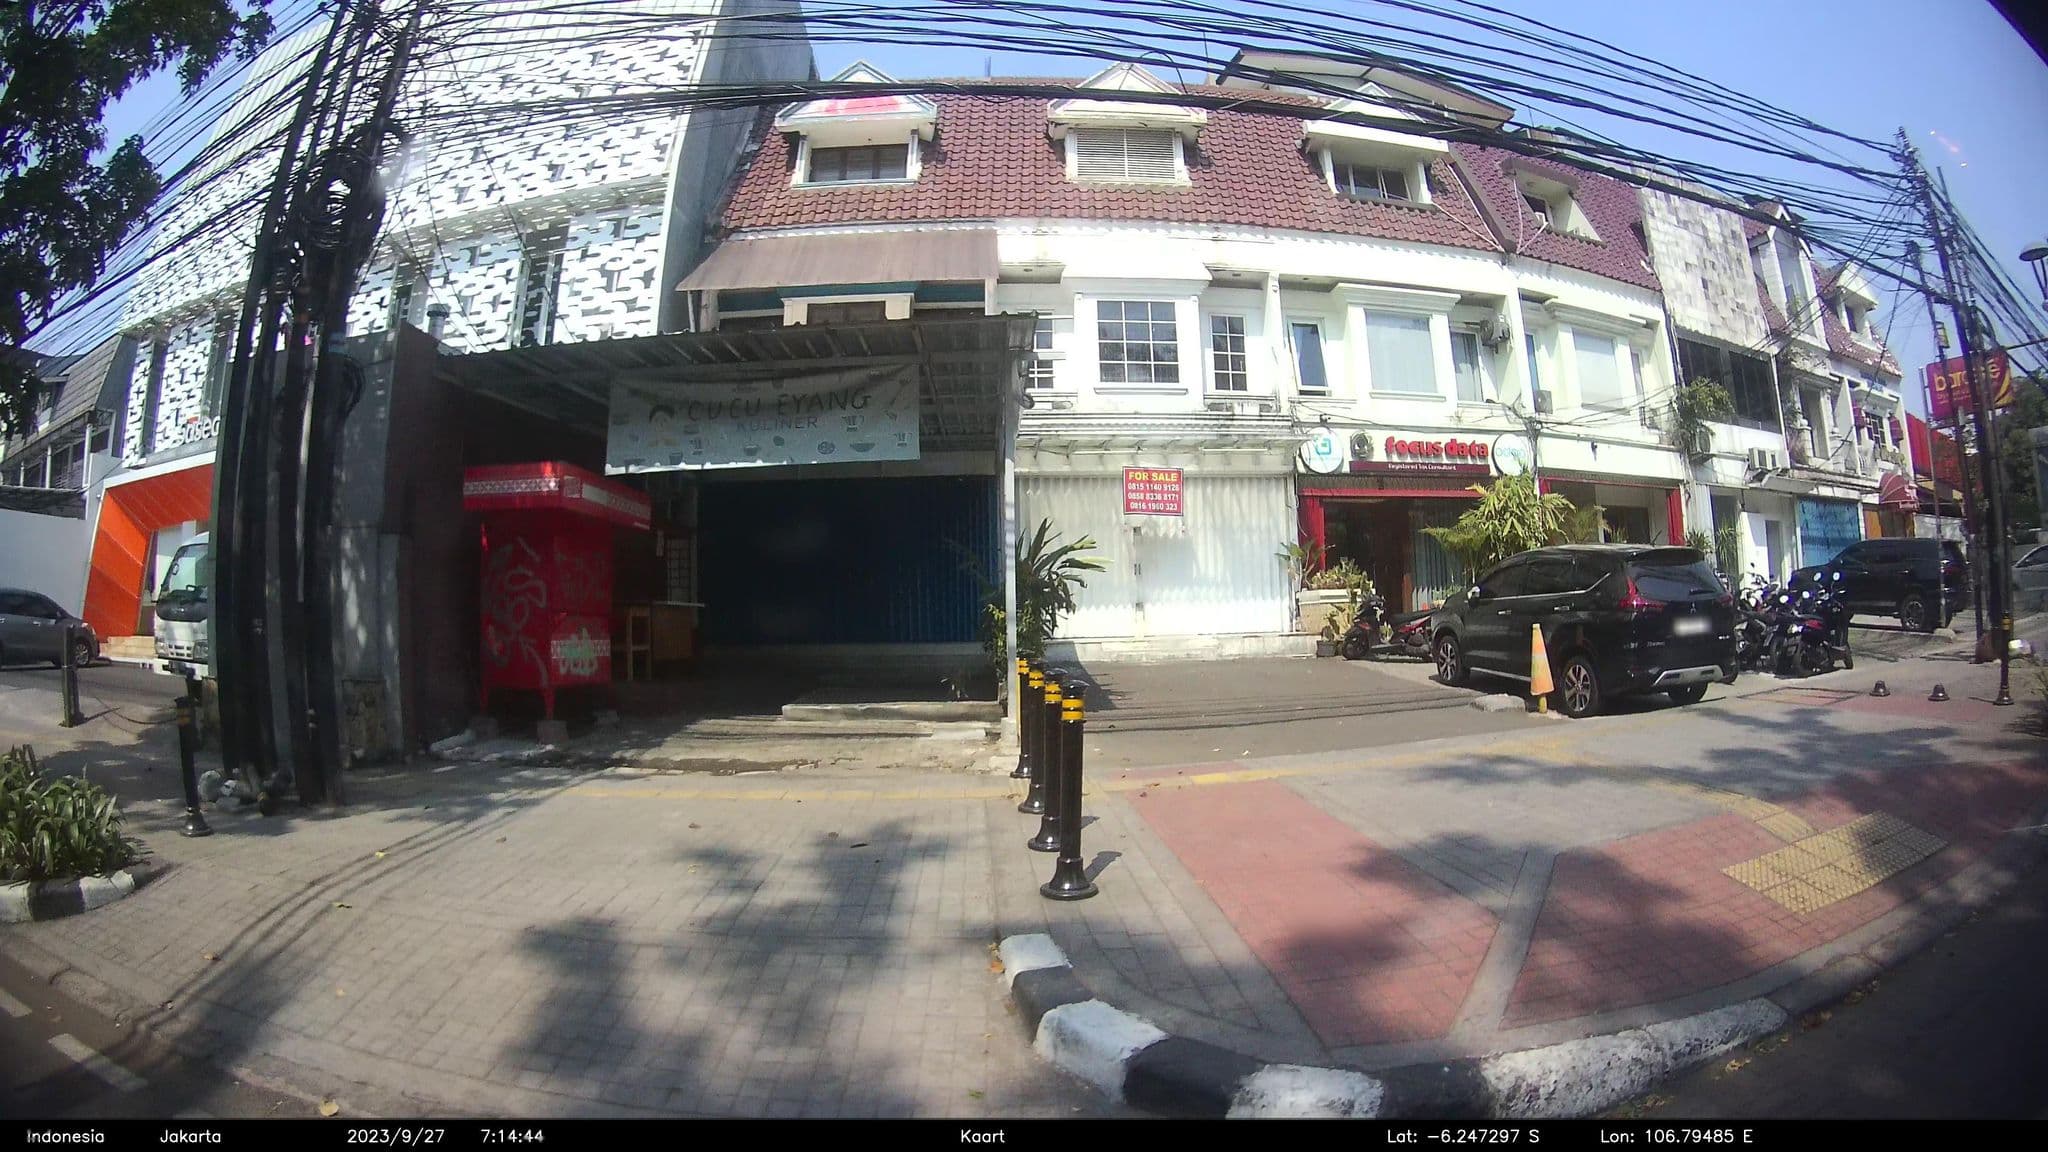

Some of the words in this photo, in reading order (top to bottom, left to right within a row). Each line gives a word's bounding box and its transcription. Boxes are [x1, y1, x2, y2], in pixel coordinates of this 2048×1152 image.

[688, 397, 761, 422] CUCU
[777, 390, 872, 416] EYANG
[736, 416, 818, 432] KULINER
[1385, 435, 1443, 456] focus
[1444, 438, 1489, 458] data
[1128, 471, 1149, 481] FOR
[1152, 472, 1178, 482] SALE
[1165, 503, 1178, 511] 323
